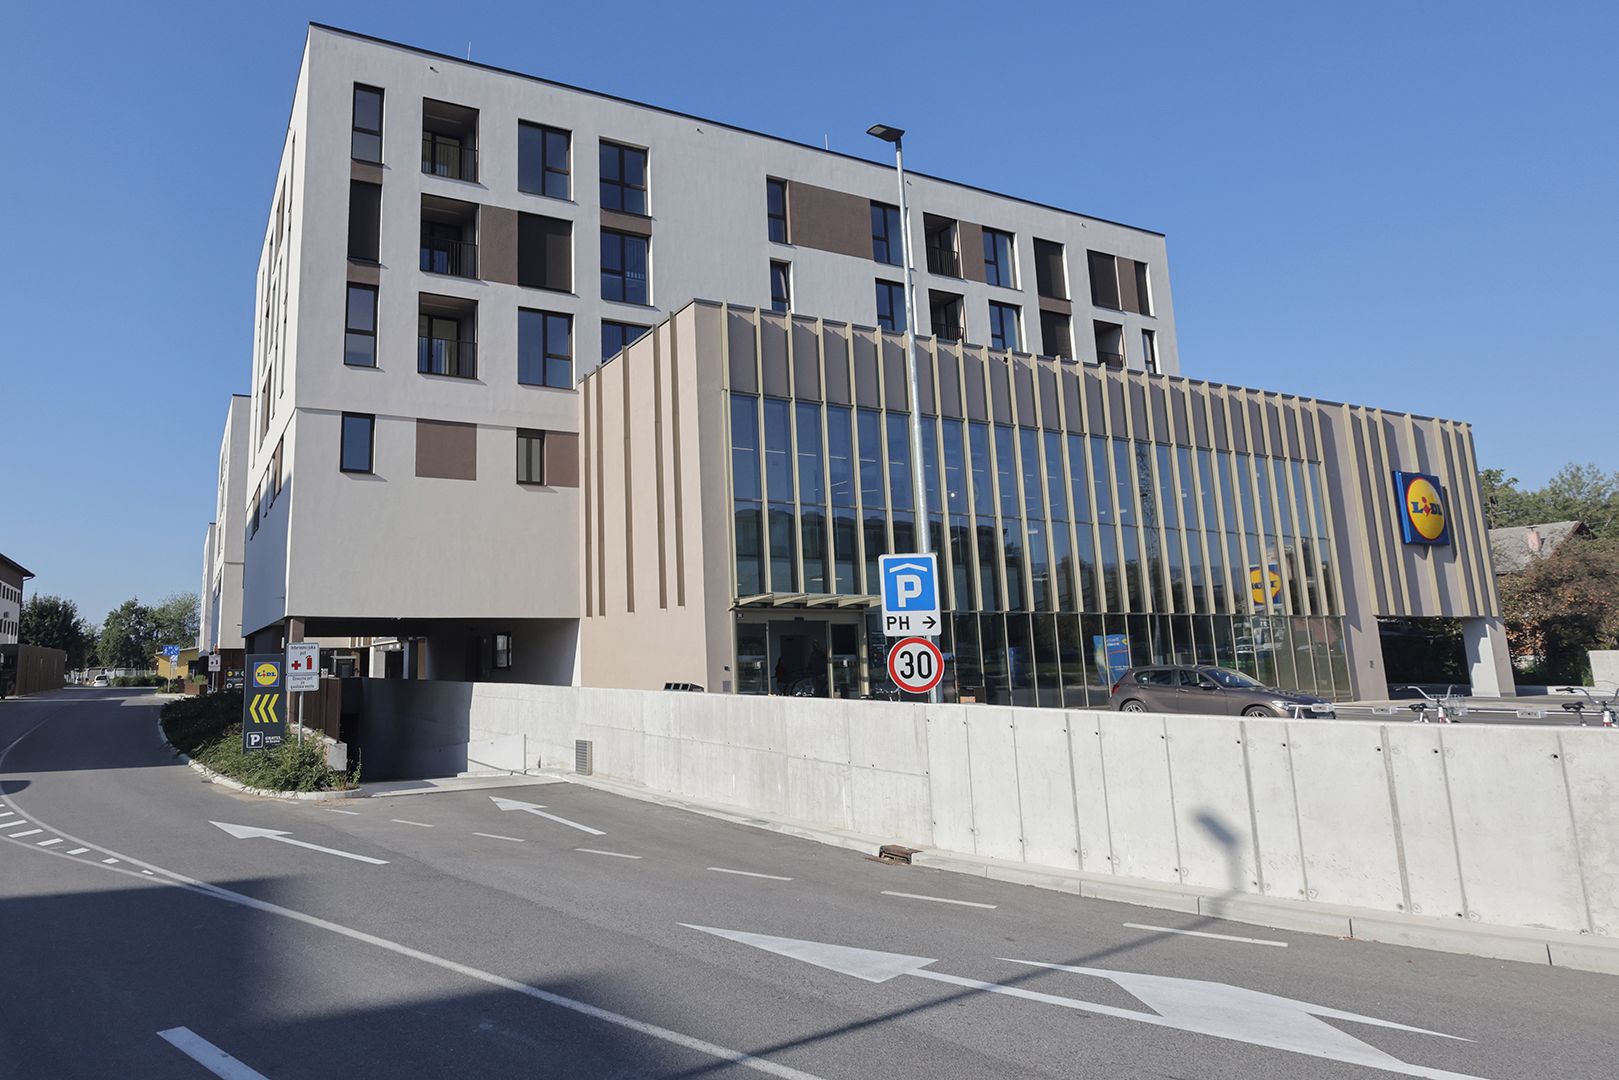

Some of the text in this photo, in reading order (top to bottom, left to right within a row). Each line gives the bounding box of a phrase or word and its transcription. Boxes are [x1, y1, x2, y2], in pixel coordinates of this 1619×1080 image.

[896, 574, 922, 608] P
[886, 616, 910, 631] PH
[900, 650, 932, 679] 30
[250, 734, 260, 746] P
